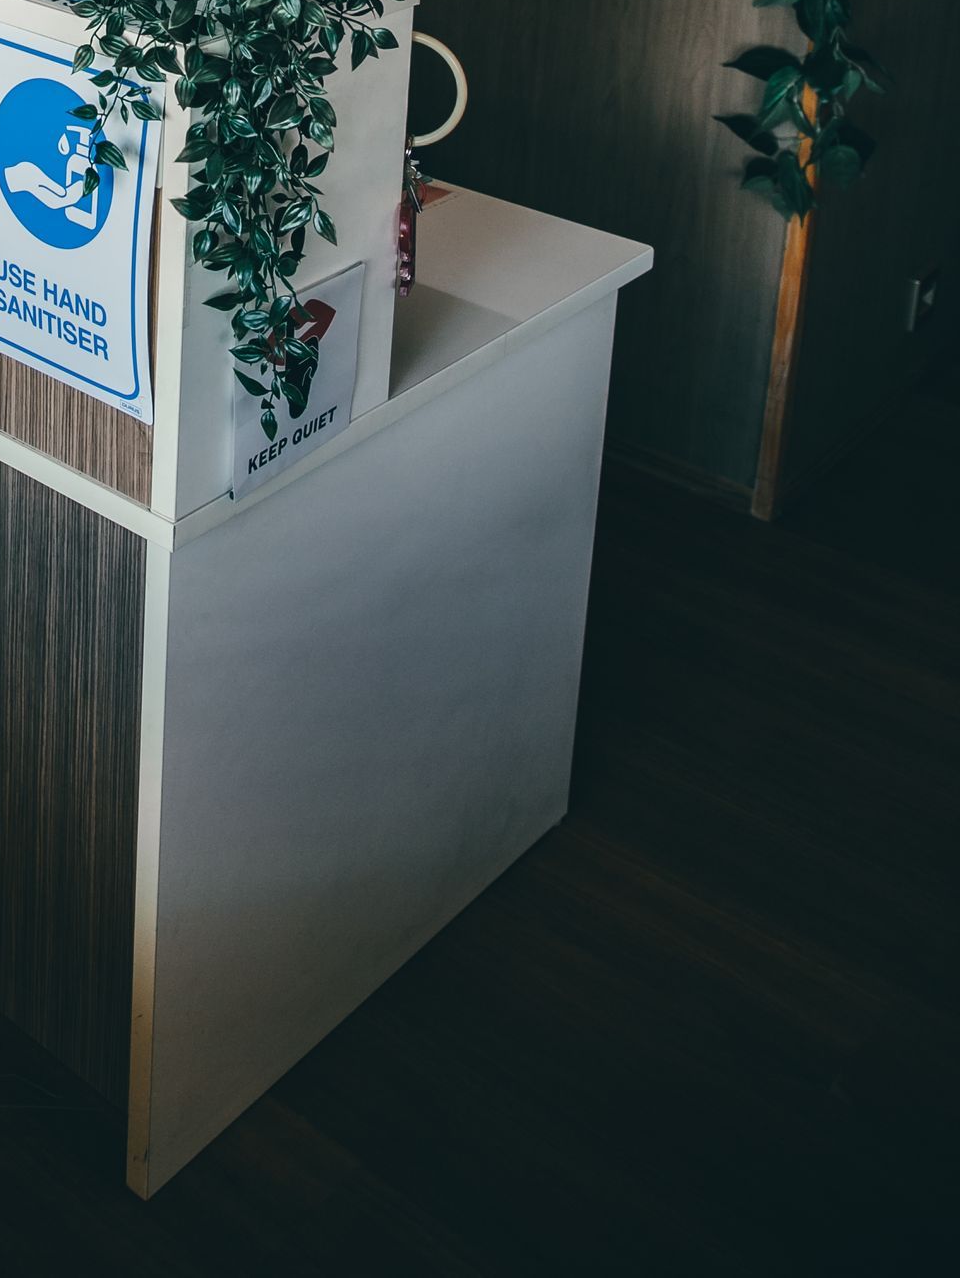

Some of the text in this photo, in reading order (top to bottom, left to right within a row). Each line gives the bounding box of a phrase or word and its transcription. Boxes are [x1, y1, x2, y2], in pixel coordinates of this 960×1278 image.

[43, 280, 108, 328] HAND
[248, 405, 338, 475] KEEP QUIET
